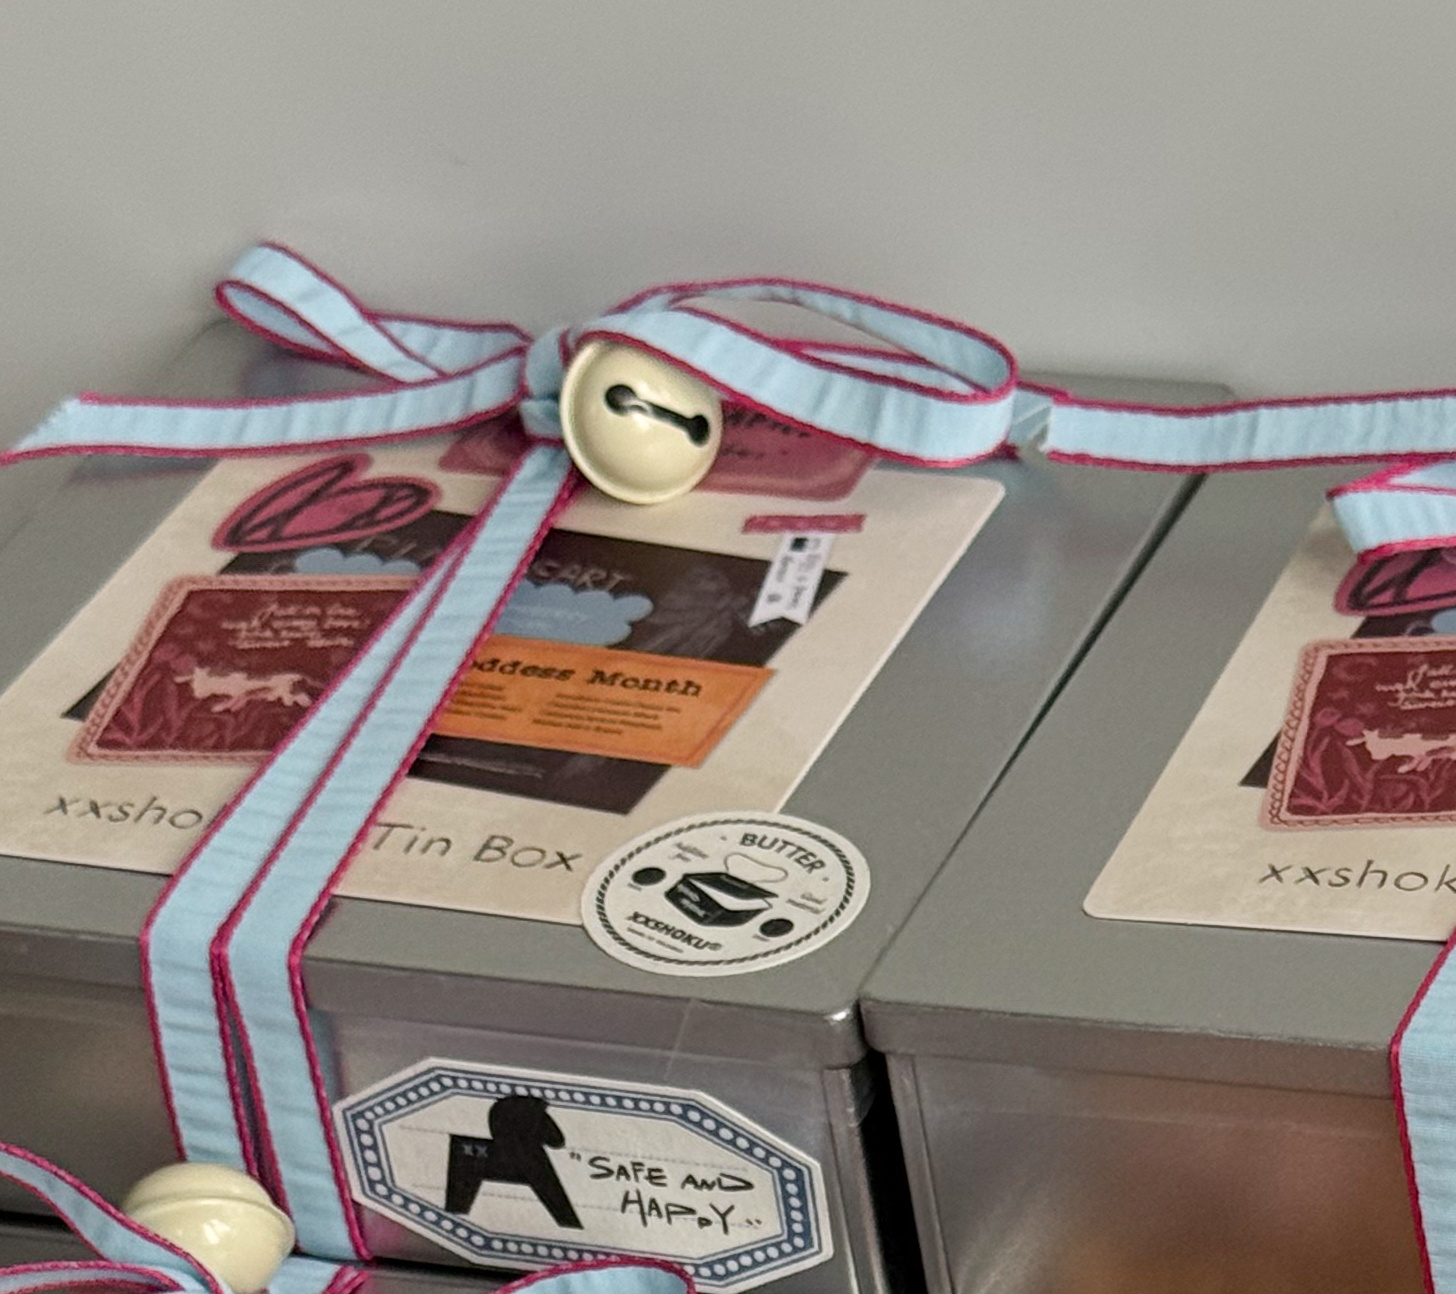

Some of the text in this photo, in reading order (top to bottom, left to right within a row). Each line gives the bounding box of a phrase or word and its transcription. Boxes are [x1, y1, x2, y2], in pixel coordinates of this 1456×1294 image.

[470, 656, 703, 699] oddess Month
[44, 796, 583, 873] xxsho Tin Box
[739, 832, 827, 875] BUTTER
